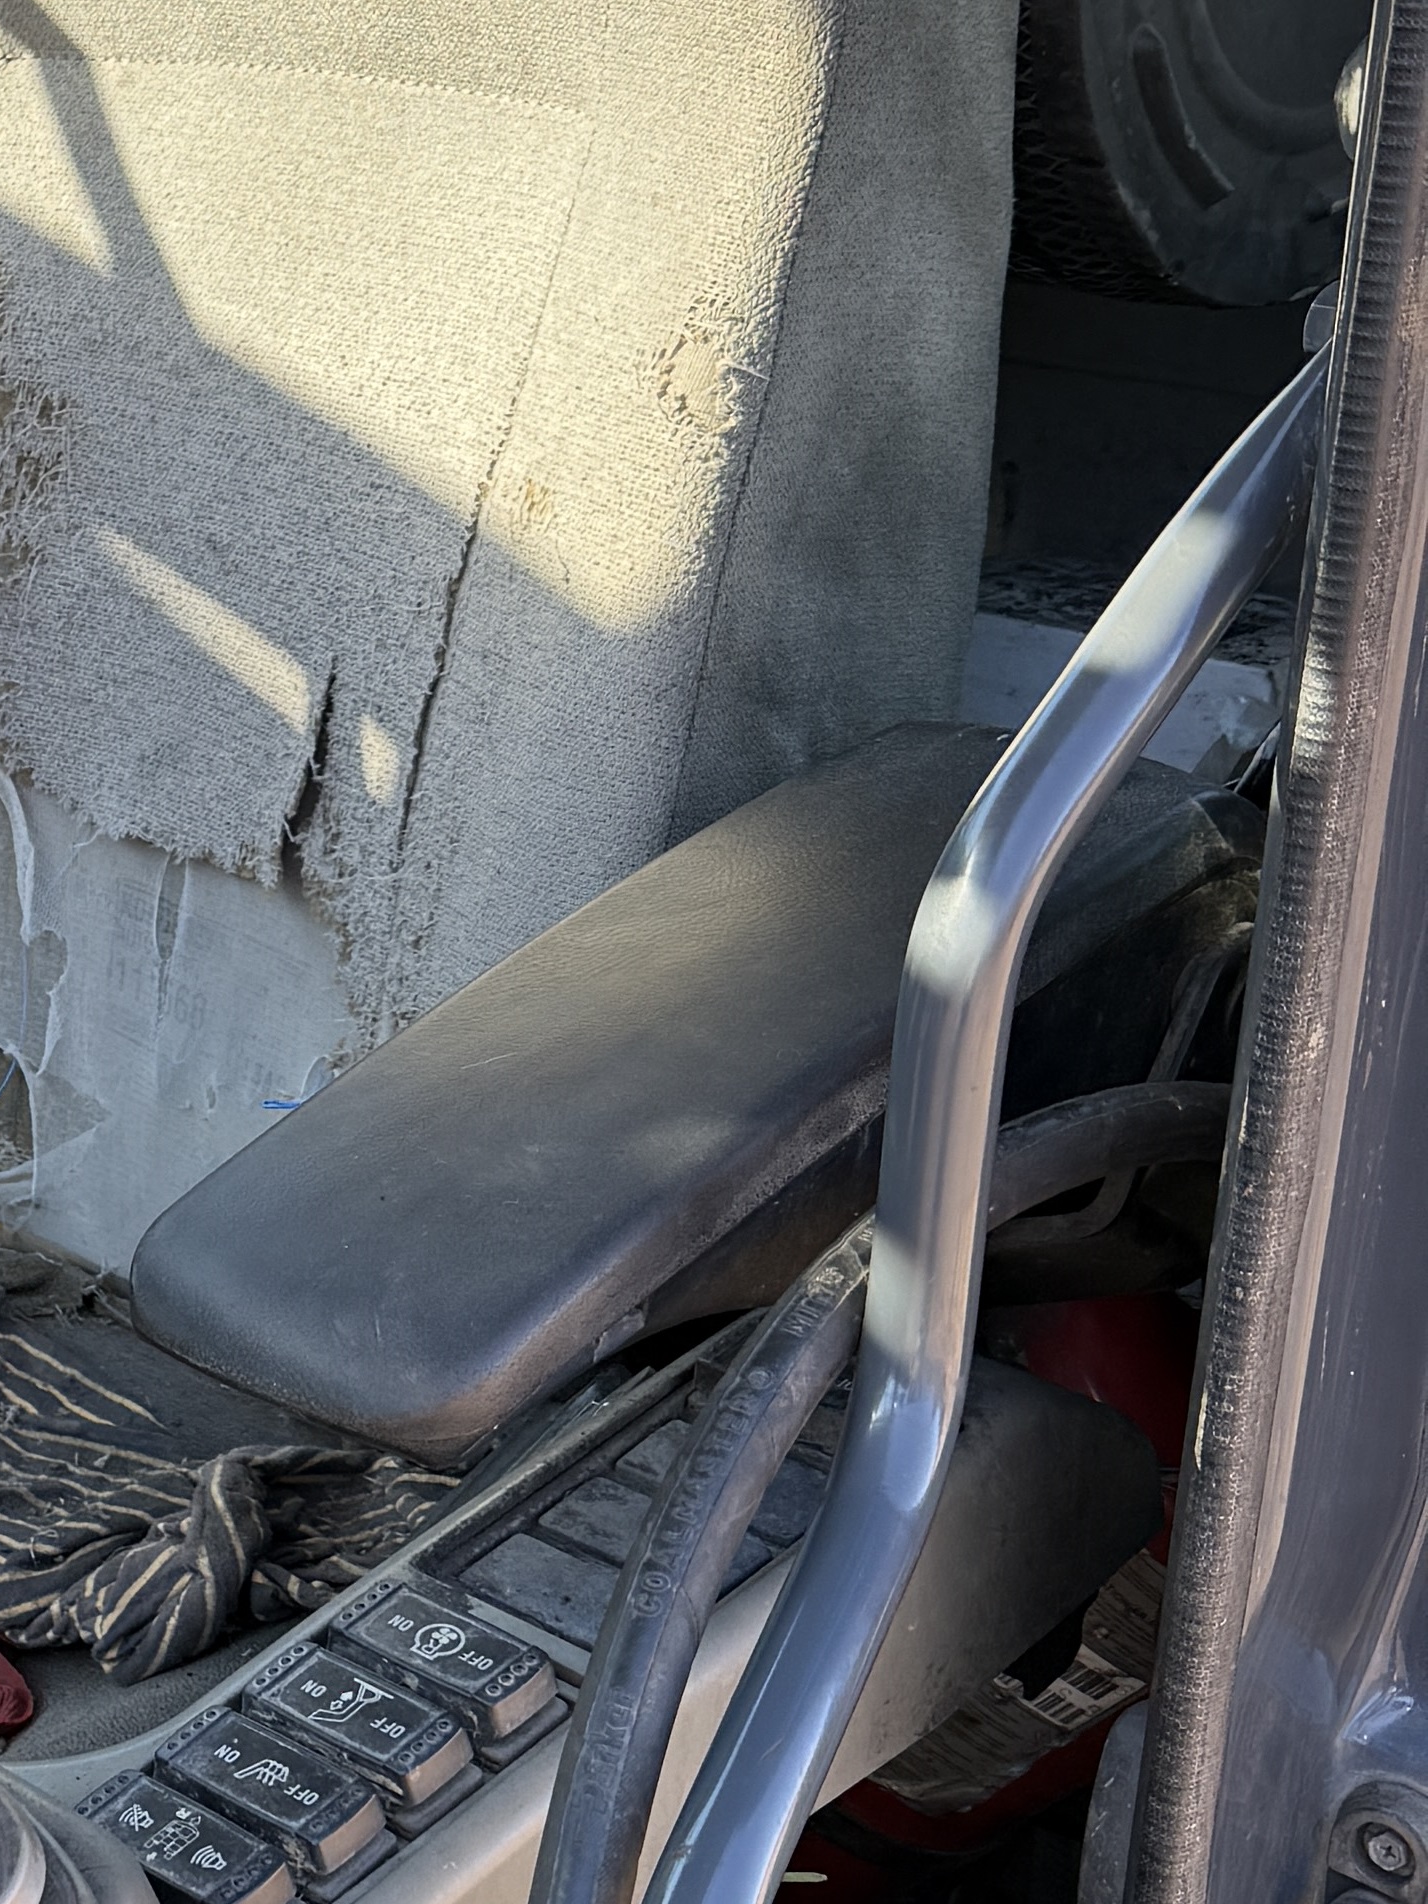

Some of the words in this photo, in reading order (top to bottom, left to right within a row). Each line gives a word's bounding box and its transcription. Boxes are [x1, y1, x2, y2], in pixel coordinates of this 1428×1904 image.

[387, 1613, 412, 1631] ON
[458, 1650, 494, 1671] OFF
[299, 1678, 327, 1698] ON
[369, 1716, 406, 1740] OFF
[213, 1744, 241, 1766] ON
[282, 1782, 320, 1806] OFF
